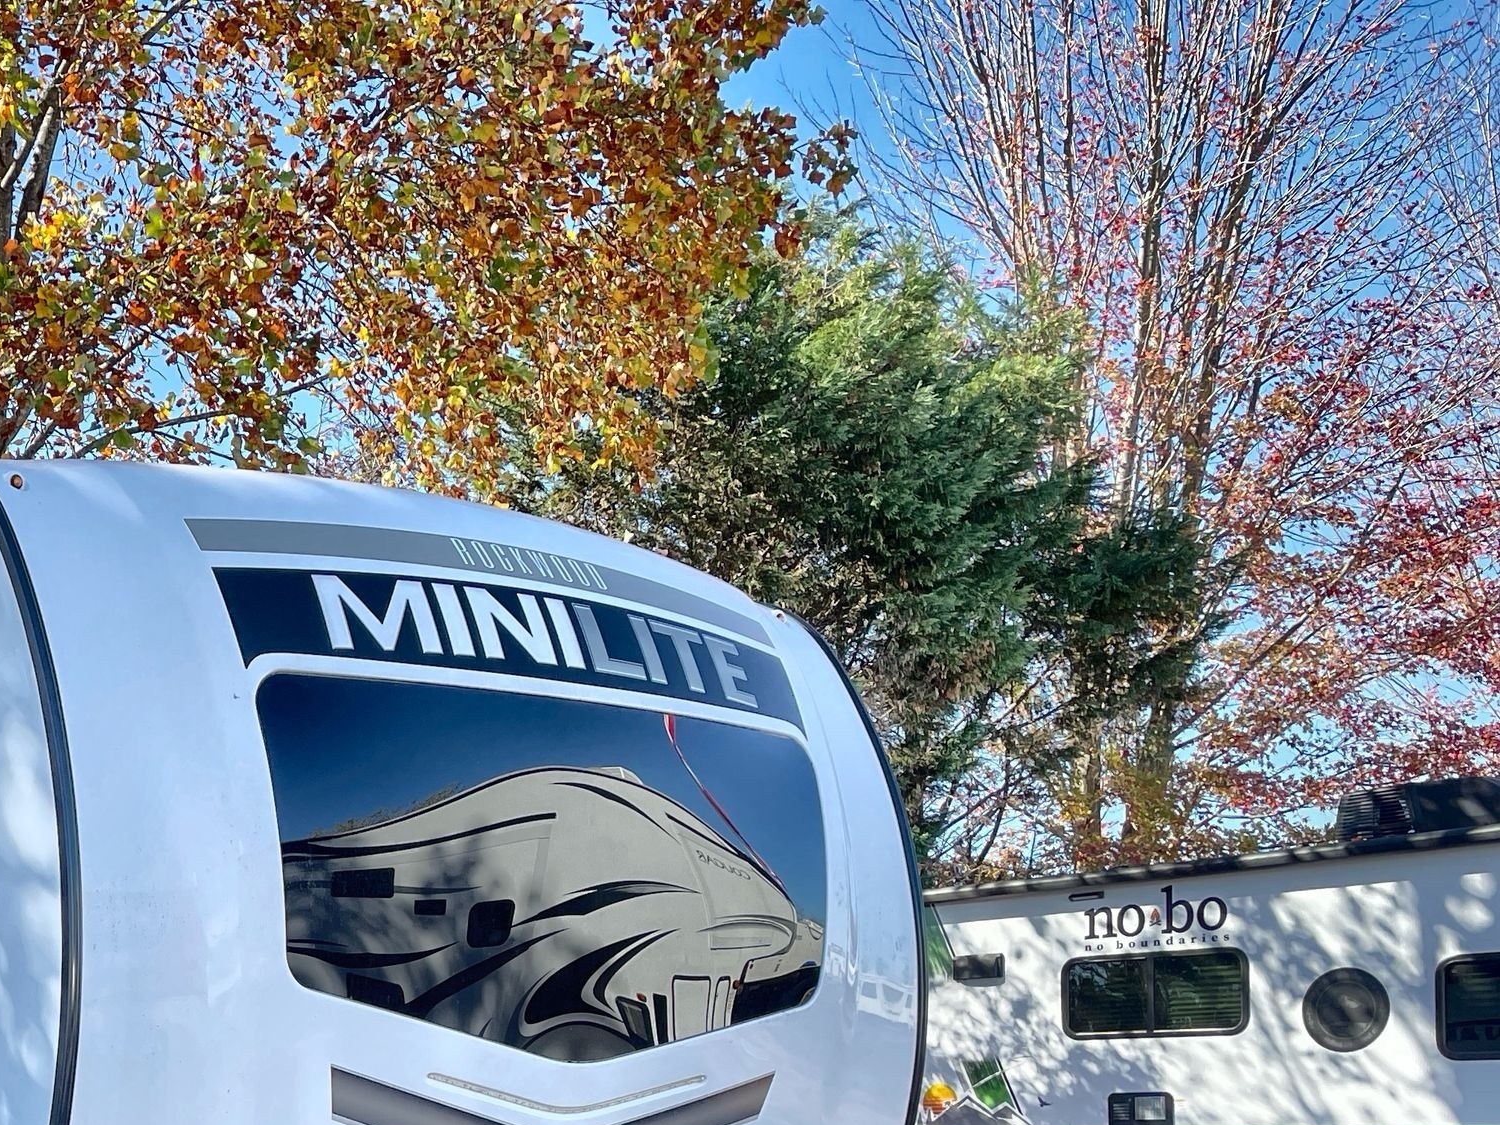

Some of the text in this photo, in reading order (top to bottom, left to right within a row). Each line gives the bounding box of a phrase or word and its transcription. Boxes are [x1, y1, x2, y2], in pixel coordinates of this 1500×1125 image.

[450, 537, 608, 590] ROCKWOOD
[311, 574, 758, 708] MINILITE
[1116, 934, 1230, 949] boundaries
